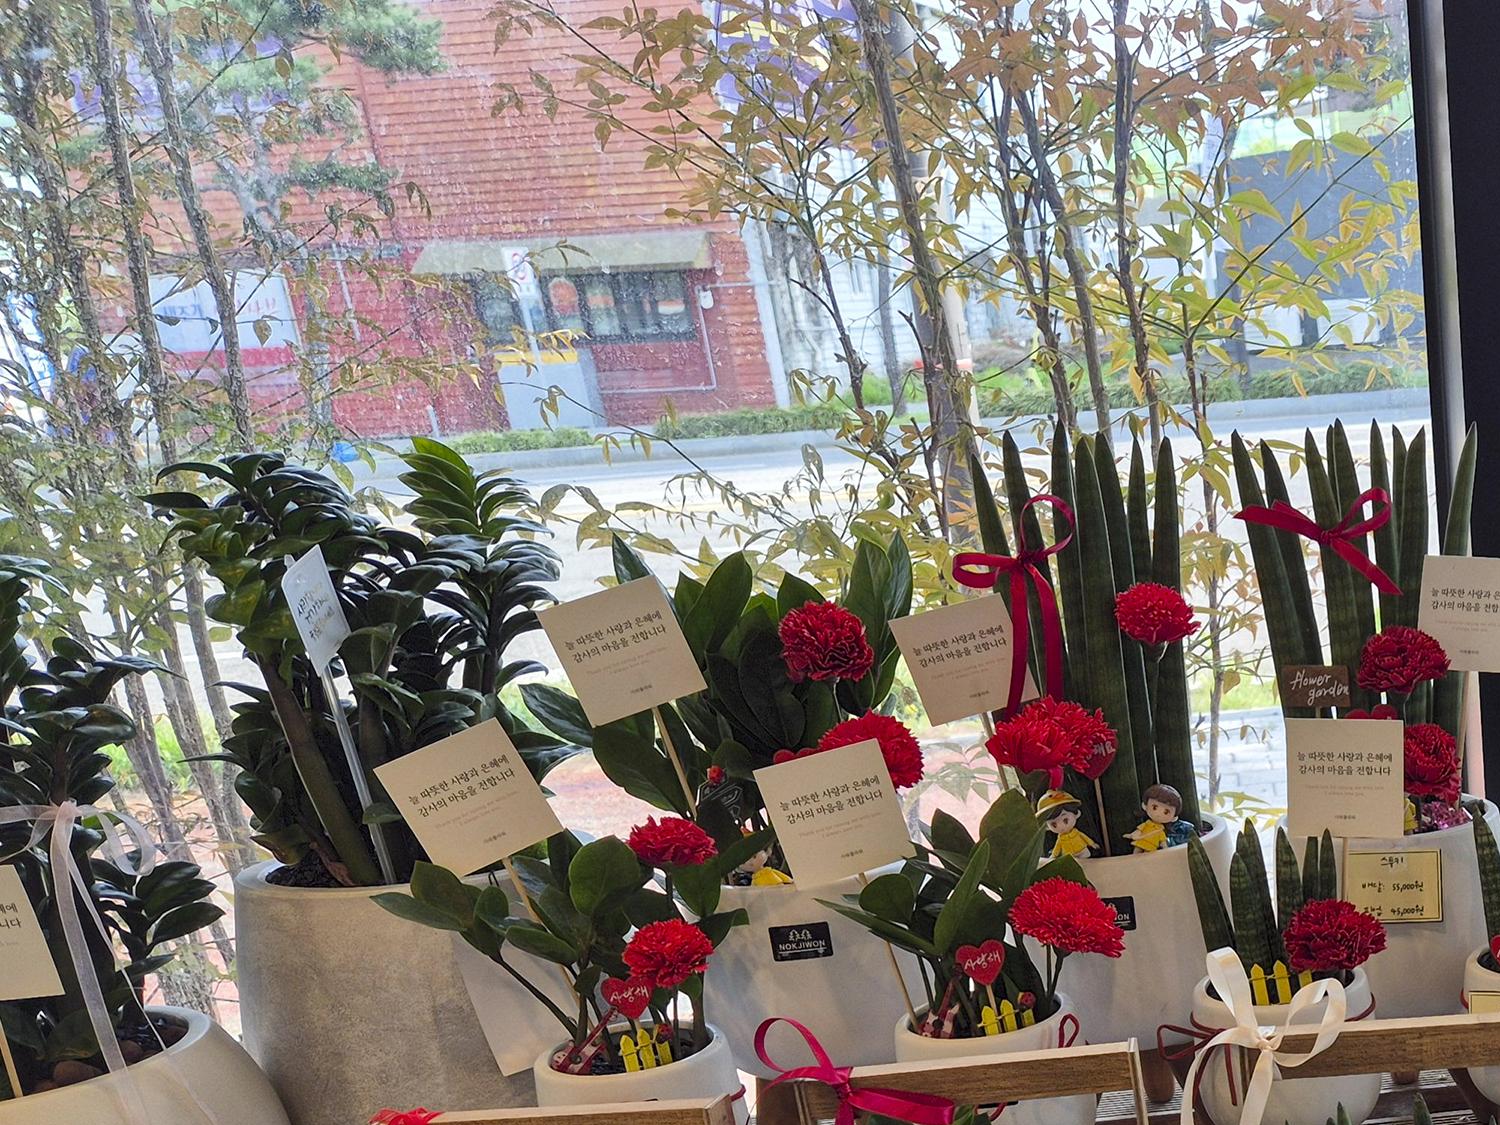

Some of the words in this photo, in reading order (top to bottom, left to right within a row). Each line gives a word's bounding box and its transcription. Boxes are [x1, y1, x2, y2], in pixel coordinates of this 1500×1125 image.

[564, 641, 575, 651] 늘
[576, 630, 605, 646] 따뜻한
[606, 620, 633, 636] 사랑과
[635, 610, 662, 627] 은혜에
[572, 646, 601, 664] 감사의
[601, 637, 630, 653] 마음을
[630, 624, 666, 644] 전합니다
[1290, 669, 1332, 690] flower
[1308, 681, 1349, 706] garden
[1297, 751, 1306, 761] 늘
[1308, 751, 1335, 762] 따뜻한
[1337, 752, 1364, 763] 사랑과
[1366, 752, 1393, 763] 은혜에
[408, 796, 420, 805] 늘
[420, 781, 451, 798] 따뜻한
[451, 767, 479, 785] 사랑과
[481, 754, 509, 774] 은혜에
[1299, 764, 1325, 775] 감사의
[1327, 765, 1354, 776] 마음을
[1357, 766, 1392, 776] 전합니다
[418, 798, 448, 818] 감사의
[448, 786, 478, 803] 마음을
[478, 768, 515, 791] 전합니다
[780, 801, 790, 811] 늘
[791, 792, 821, 807] 따뜻한
[823, 783, 850, 799] 사랑과
[852, 775, 880, 791] 은혜에
[786, 808, 815, 825] 감사의
[816, 801, 845, 816] 마음을
[846, 789, 883, 808] 전합니다
[1392, 880, 1424, 892] 55,000원
[1391, 905, 1424, 916] 45,000원
[778, 939, 826, 951] NOKJIWON
